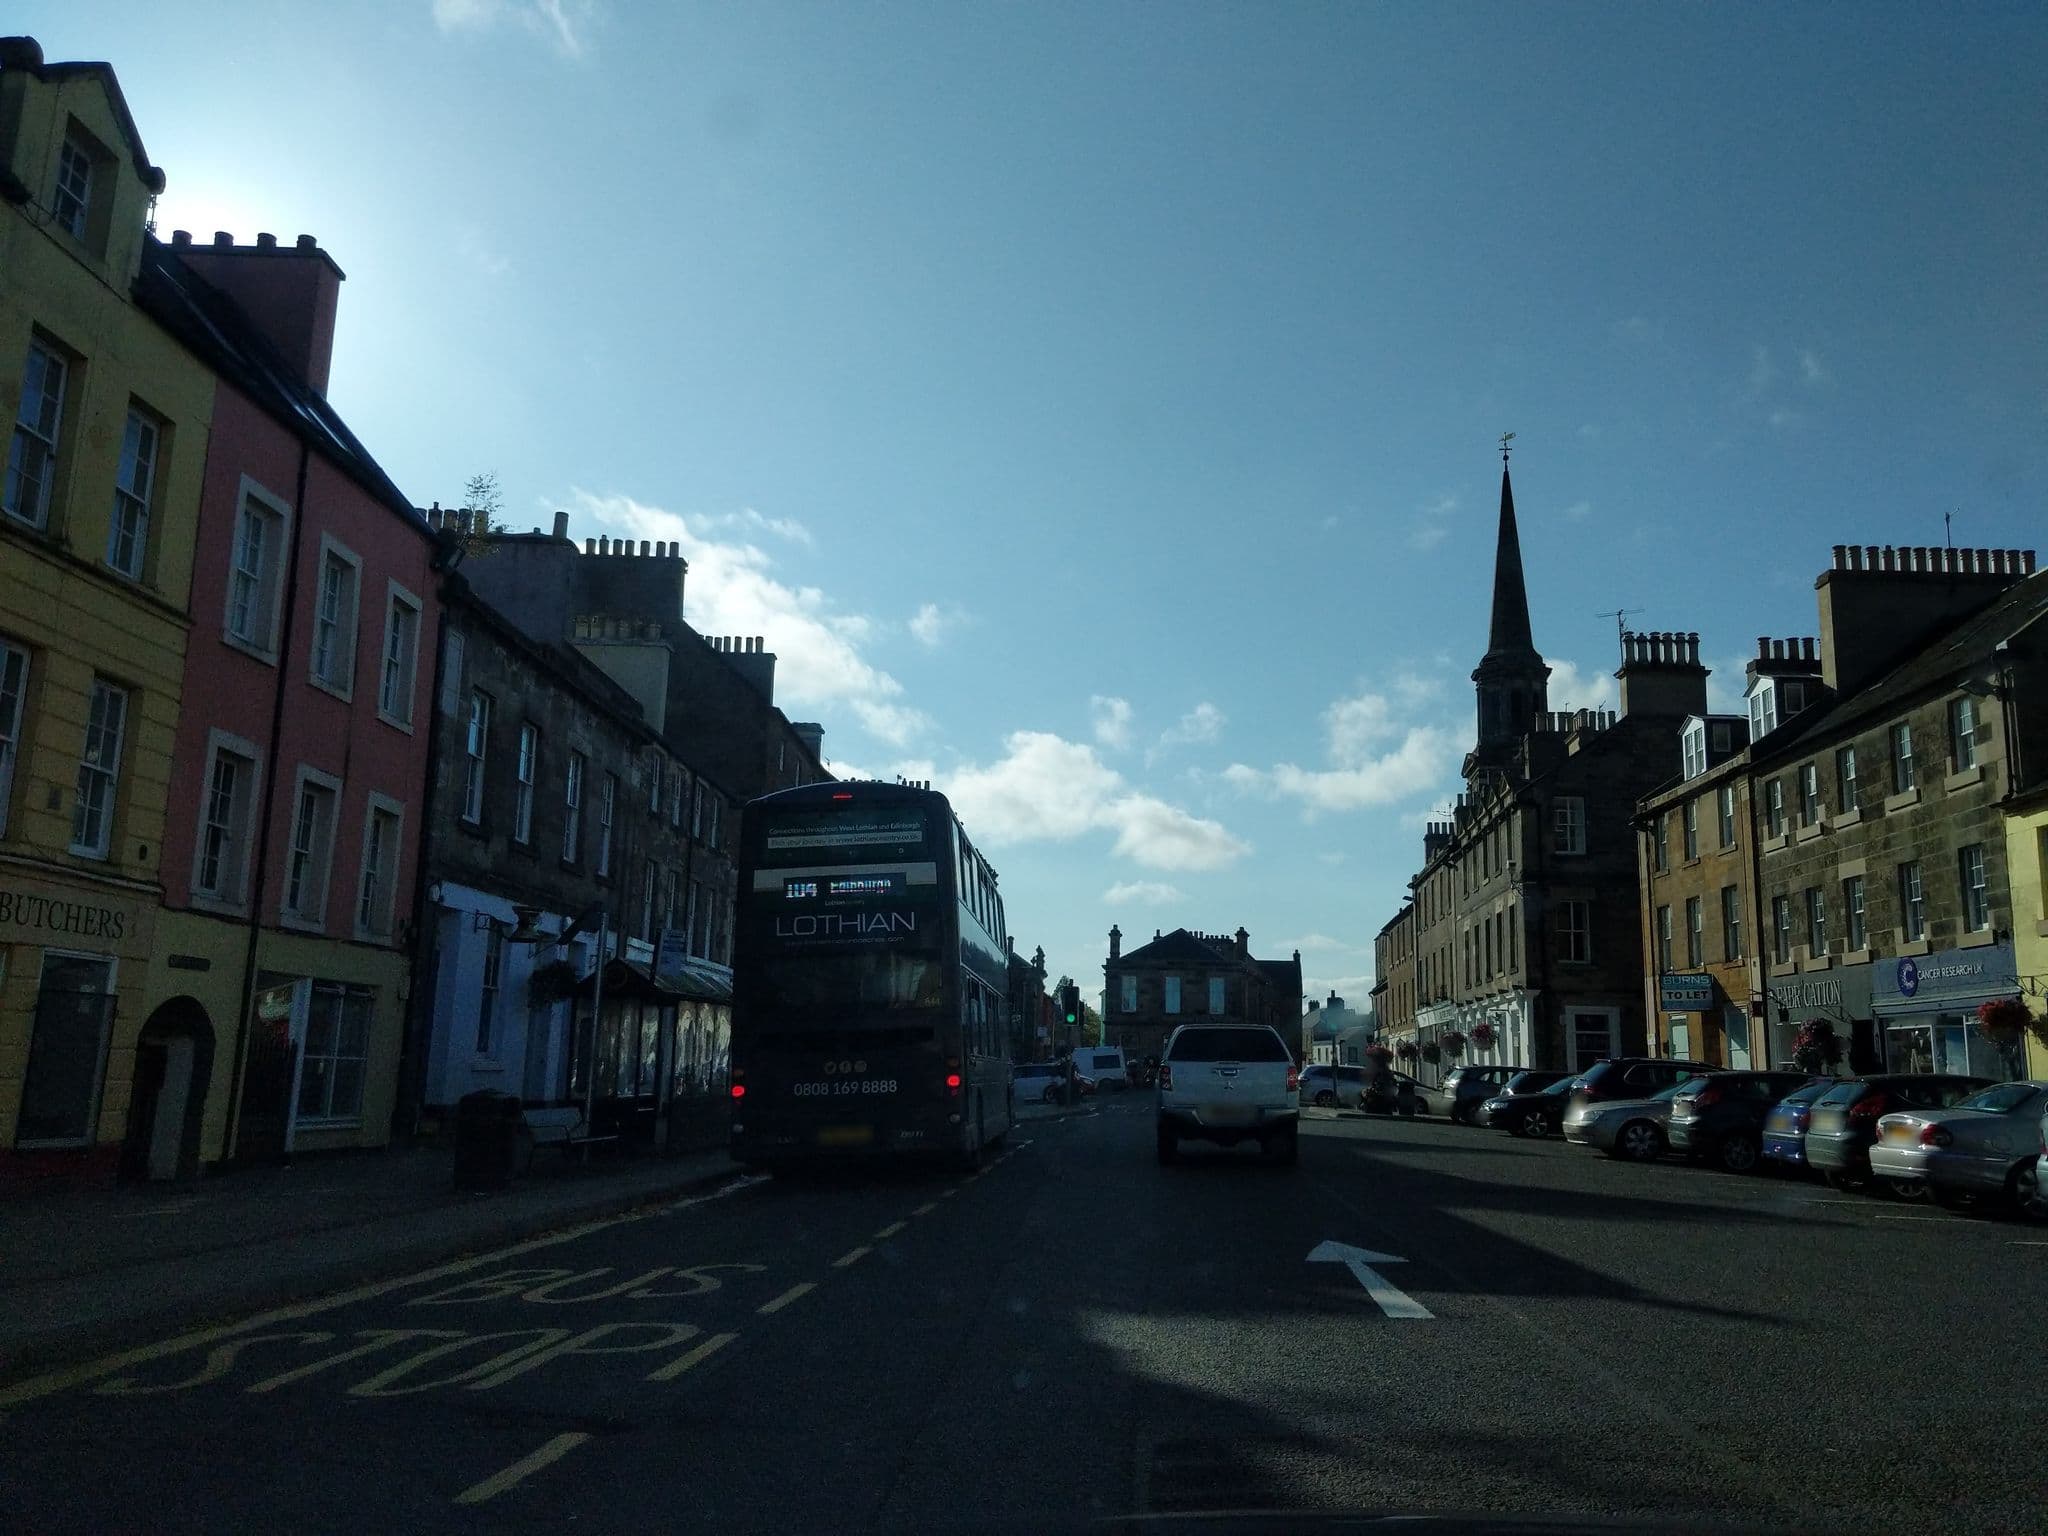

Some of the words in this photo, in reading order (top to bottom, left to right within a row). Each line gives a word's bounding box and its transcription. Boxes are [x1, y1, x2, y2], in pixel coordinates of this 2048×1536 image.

[0, 892, 124, 939] BUTCHERS
[776, 911, 916, 937] LOTHIAN
[1663, 975, 1710, 985] BURNS
[1917, 967, 1941, 981] CANCER
[1942, 963, 1972, 978] RESEARCH
[1666, 991, 1683, 1000] TO
[1686, 990, 1708, 1000] LET
[793, 1081, 828, 1096] 0808
[832, 1081, 858, 1095] 169
[861, 1079, 898, 1094] 8888
[405, 1264, 767, 1306] BUS
[91, 1322, 700, 1397] STOP
